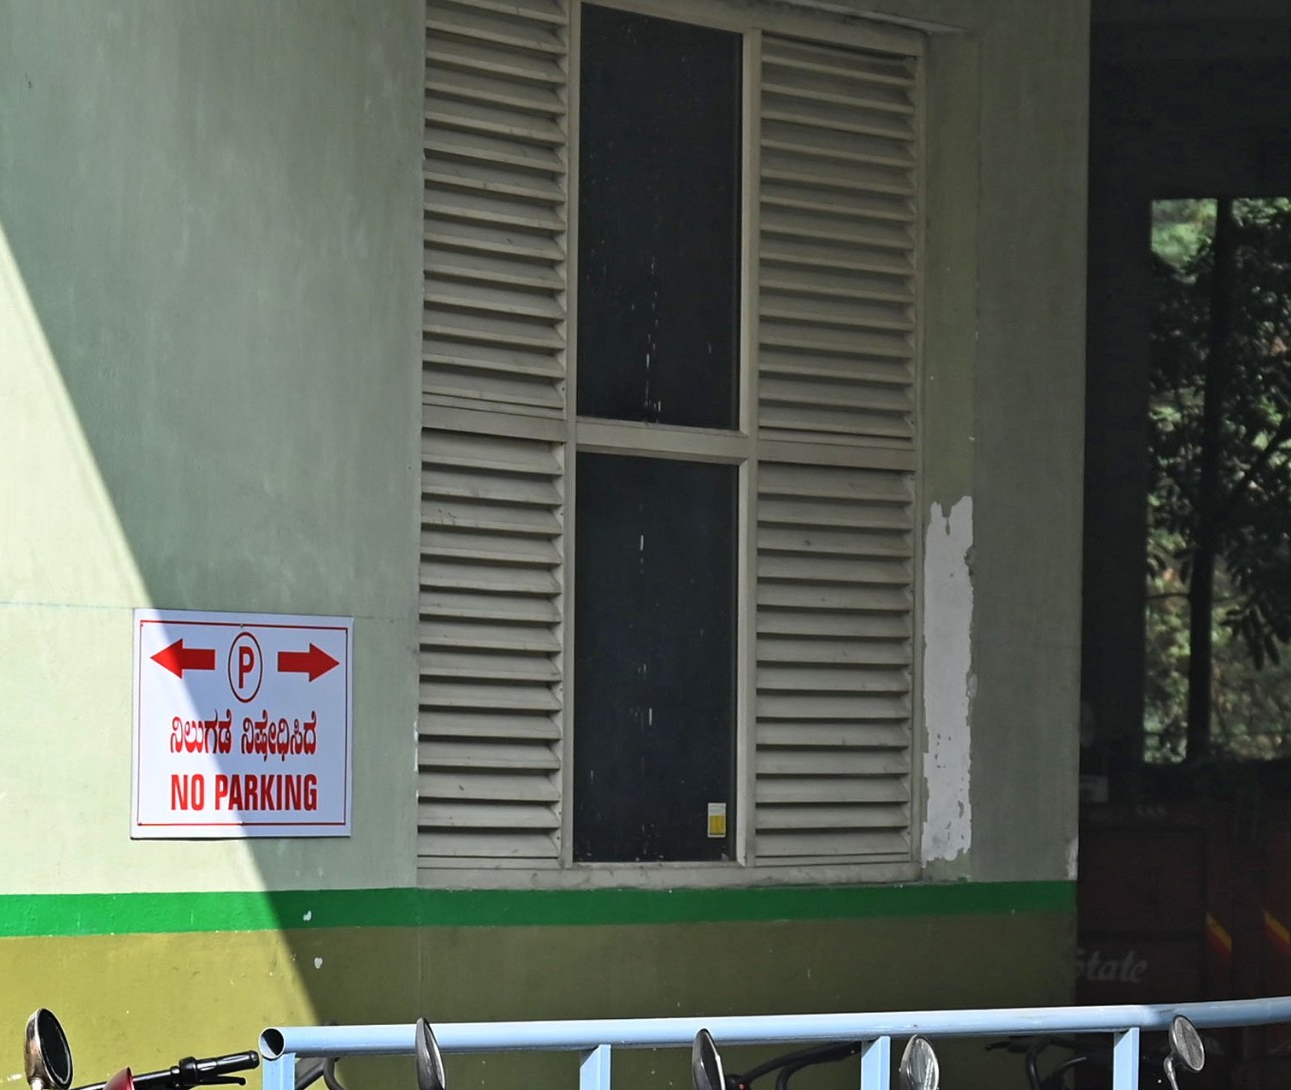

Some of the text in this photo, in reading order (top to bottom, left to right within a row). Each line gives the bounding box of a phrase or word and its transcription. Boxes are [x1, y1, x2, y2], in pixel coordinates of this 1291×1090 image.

[238, 645, 255, 689] P
[170, 708, 233, 755] ನಿಲುಗಡೆ
[171, 774, 317, 811] NO PARKING
